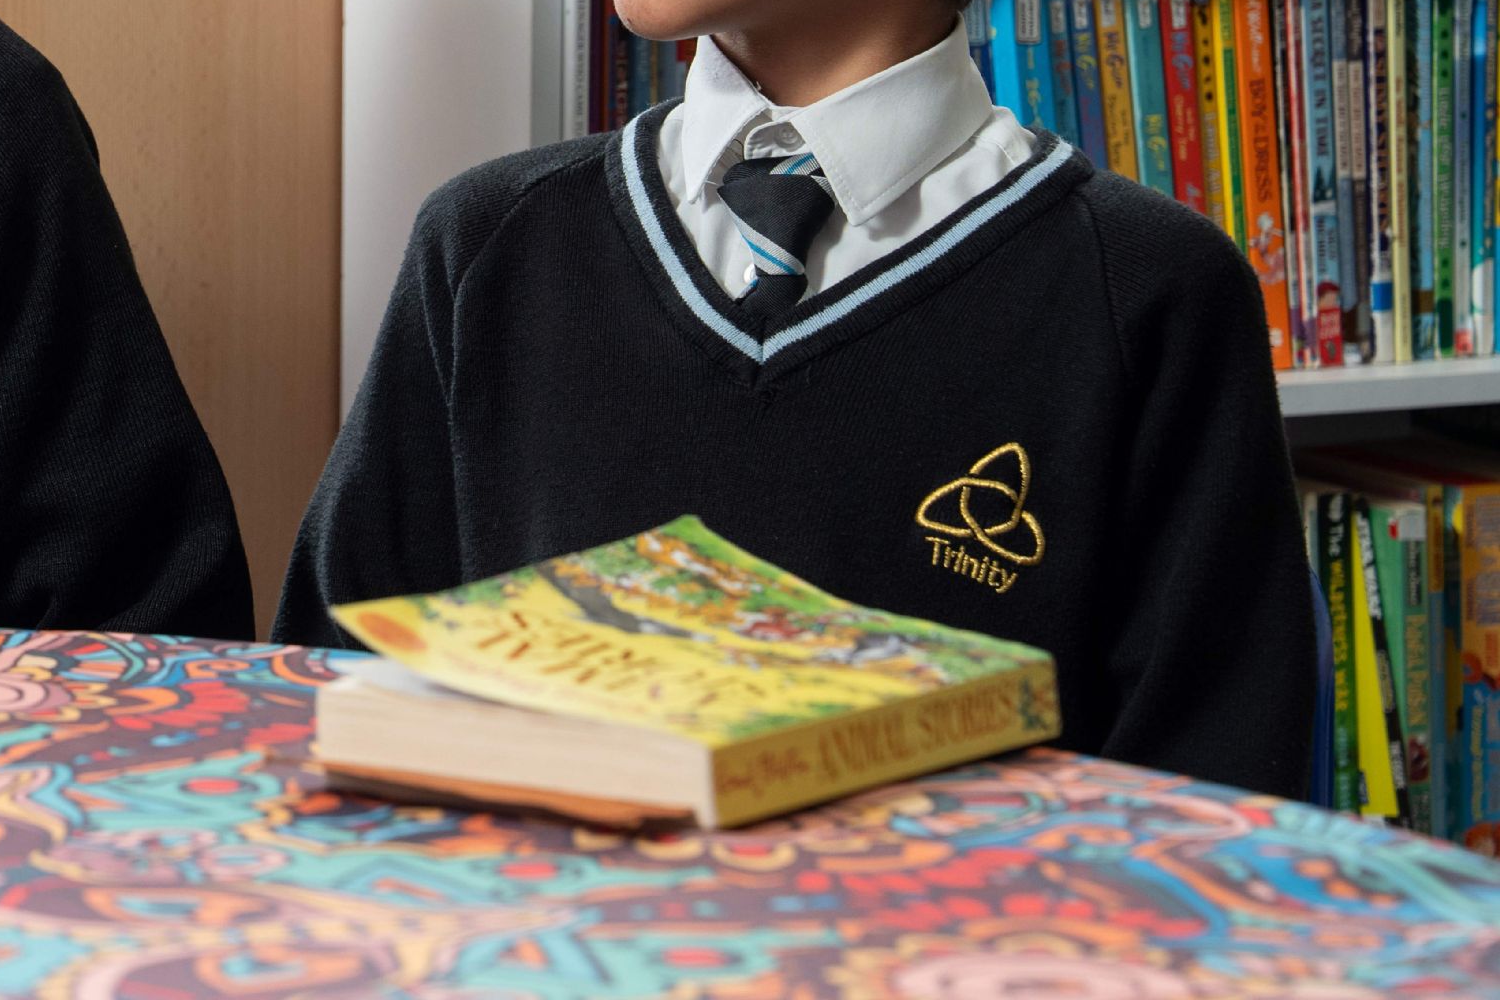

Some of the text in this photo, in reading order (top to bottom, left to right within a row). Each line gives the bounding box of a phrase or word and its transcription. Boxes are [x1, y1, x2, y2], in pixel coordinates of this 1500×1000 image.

[1105, 32, 1125, 89] Mr Gum
[1171, 31, 1193, 90] Mr Gum
[1310, 0, 1329, 157] A SECRET IN TIME
[1145, 113, 1162, 135] Mr
[1249, 78, 1267, 121] BOY
[1146, 135, 1167, 171] Gum
[1248, 133, 1271, 202] DRESS
[924, 536, 1018, 594] Trinity
[1328, 525, 1343, 557] The
[1356, 514, 1382, 621] STAR WARS
[1329, 559, 1347, 662] WILDERNESS
[1334, 668, 1349, 711] WAR
[817, 714, 913, 783] ANIMAL
[916, 681, 1014, 750] STORIES
